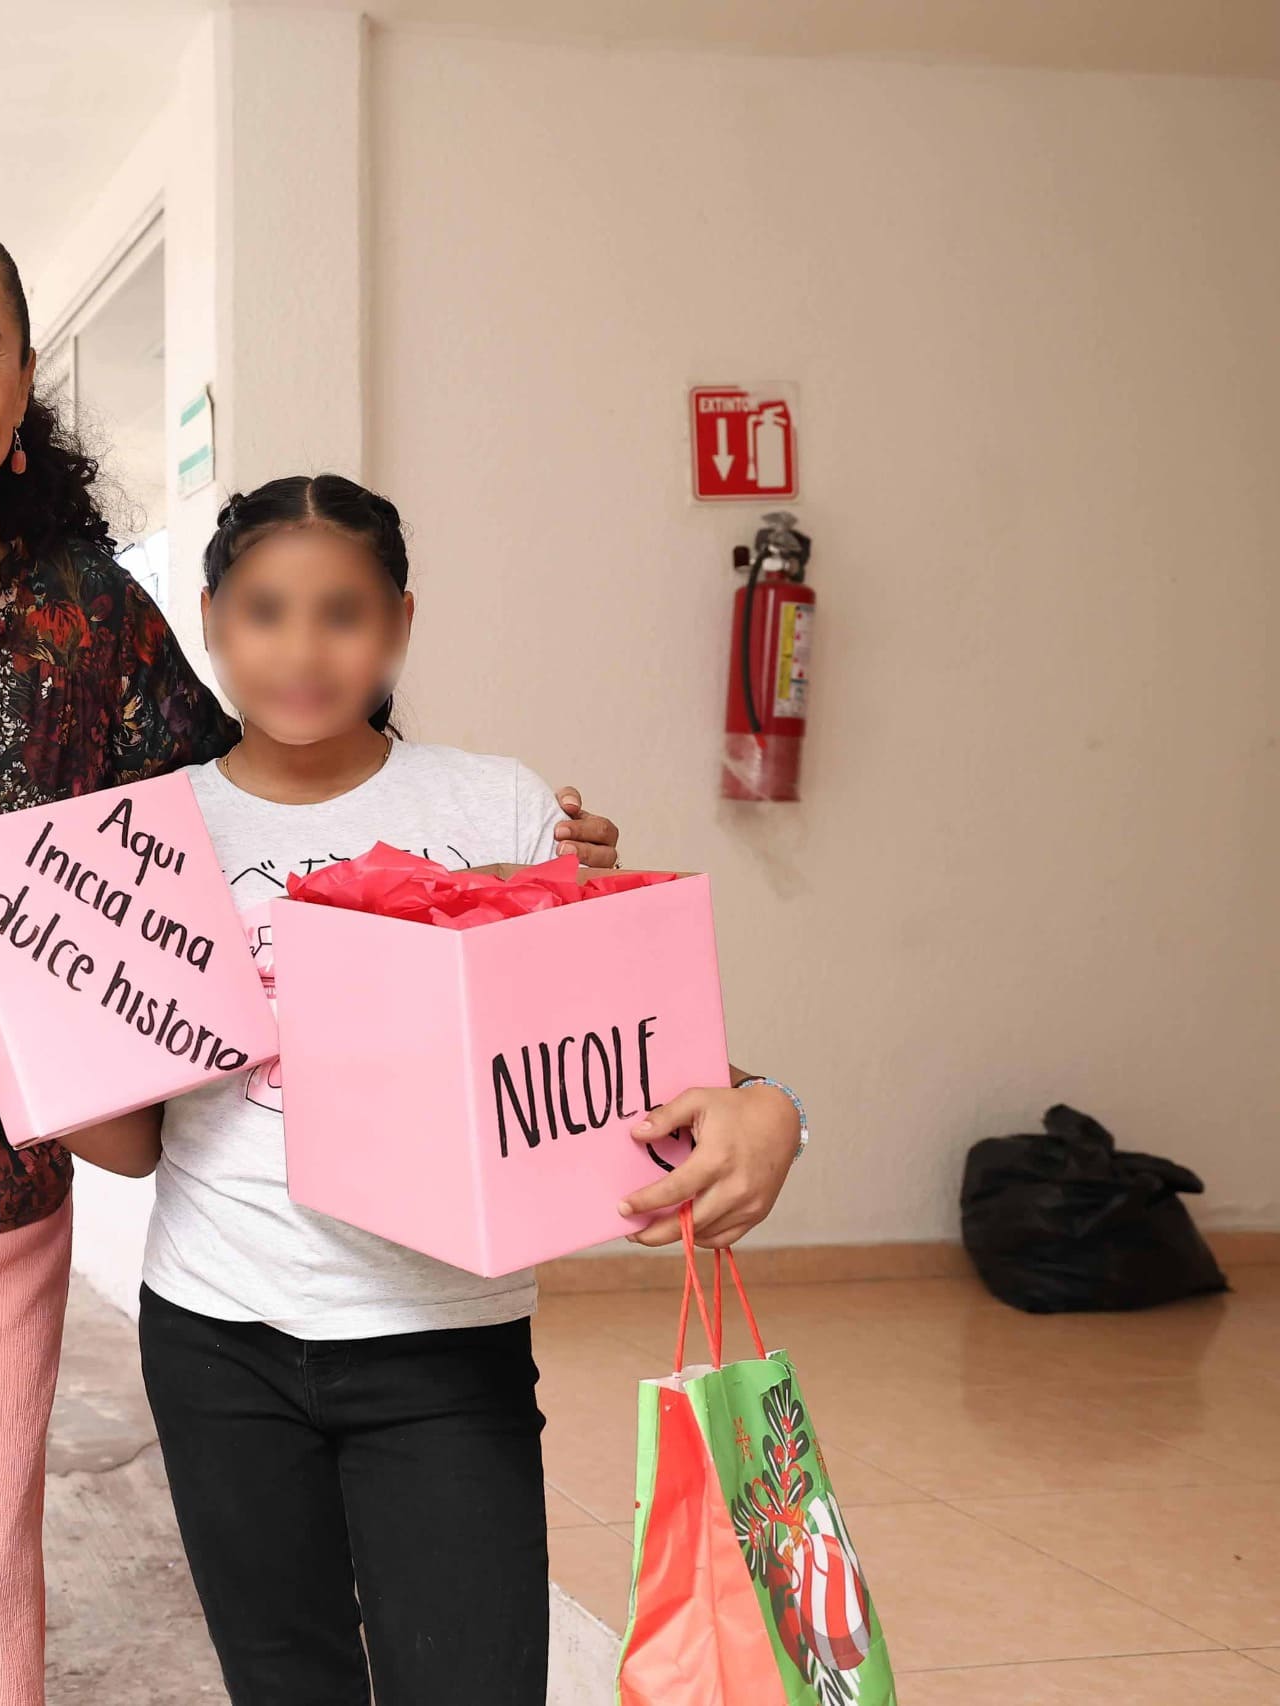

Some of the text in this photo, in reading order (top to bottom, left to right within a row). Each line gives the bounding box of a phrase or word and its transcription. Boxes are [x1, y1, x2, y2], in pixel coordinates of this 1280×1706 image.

[699, 396, 759, 413] EXTINTO
[25, 821, 133, 928] Inicia
[141, 908, 215, 974] una
[96, 797, 186, 887] Aqui
[100, 960, 249, 1073] historia
[492, 1016, 664, 1158] NICOLE
